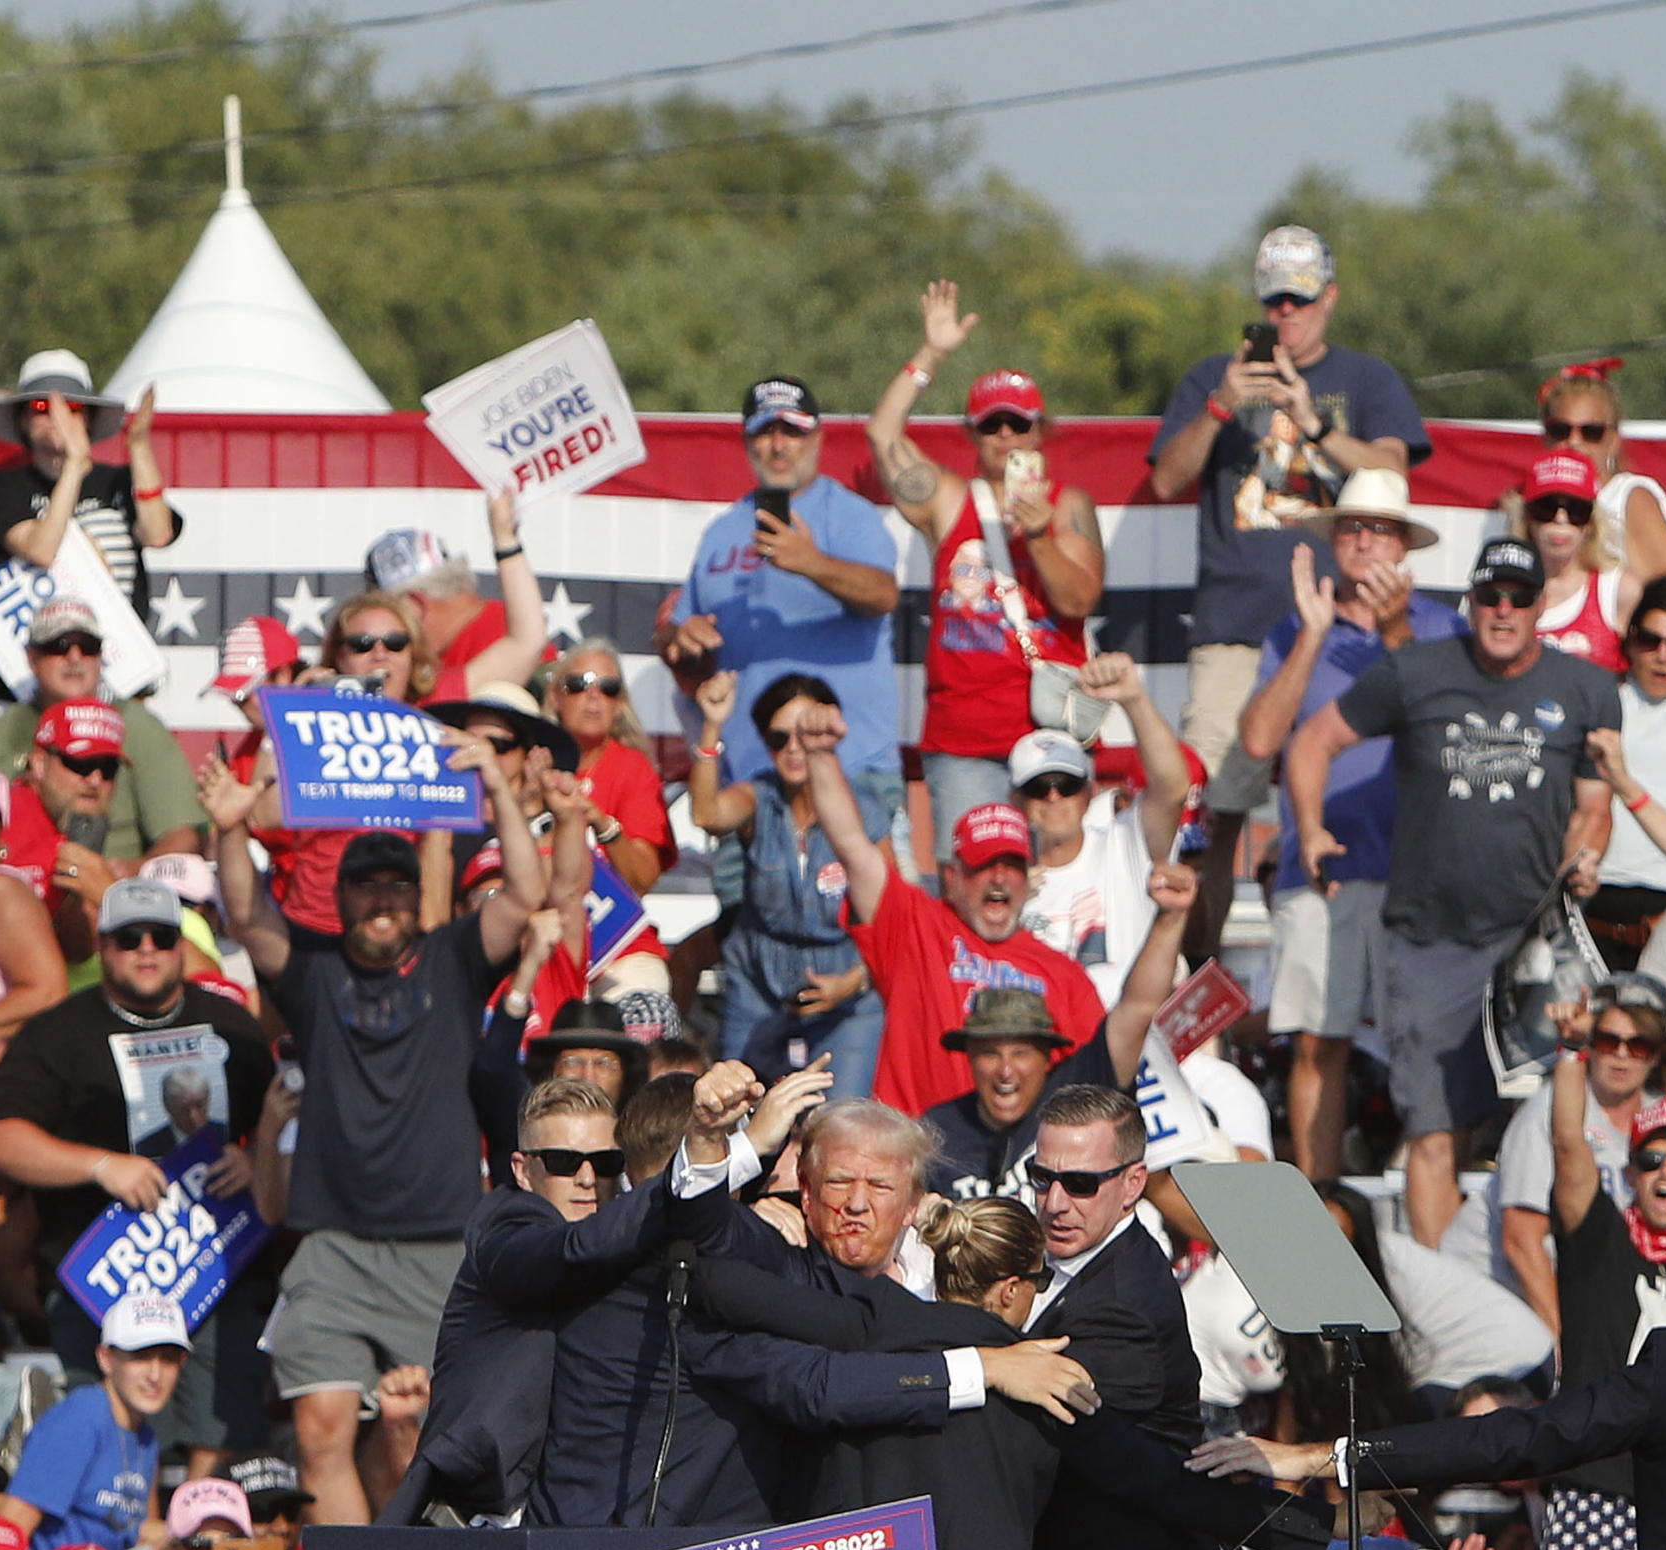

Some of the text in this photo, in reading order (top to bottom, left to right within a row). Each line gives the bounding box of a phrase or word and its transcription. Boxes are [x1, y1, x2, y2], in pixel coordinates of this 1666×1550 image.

[488, 387, 595, 457] YOU'RE
[513, 414, 616, 493] FIRED!
[708, 550, 763, 573] US
[320, 742, 440, 783] 2024
[299, 781, 338, 801] TEXT
[397, 782, 419, 801] TO
[86, 1162, 212, 1298] TRUMP
